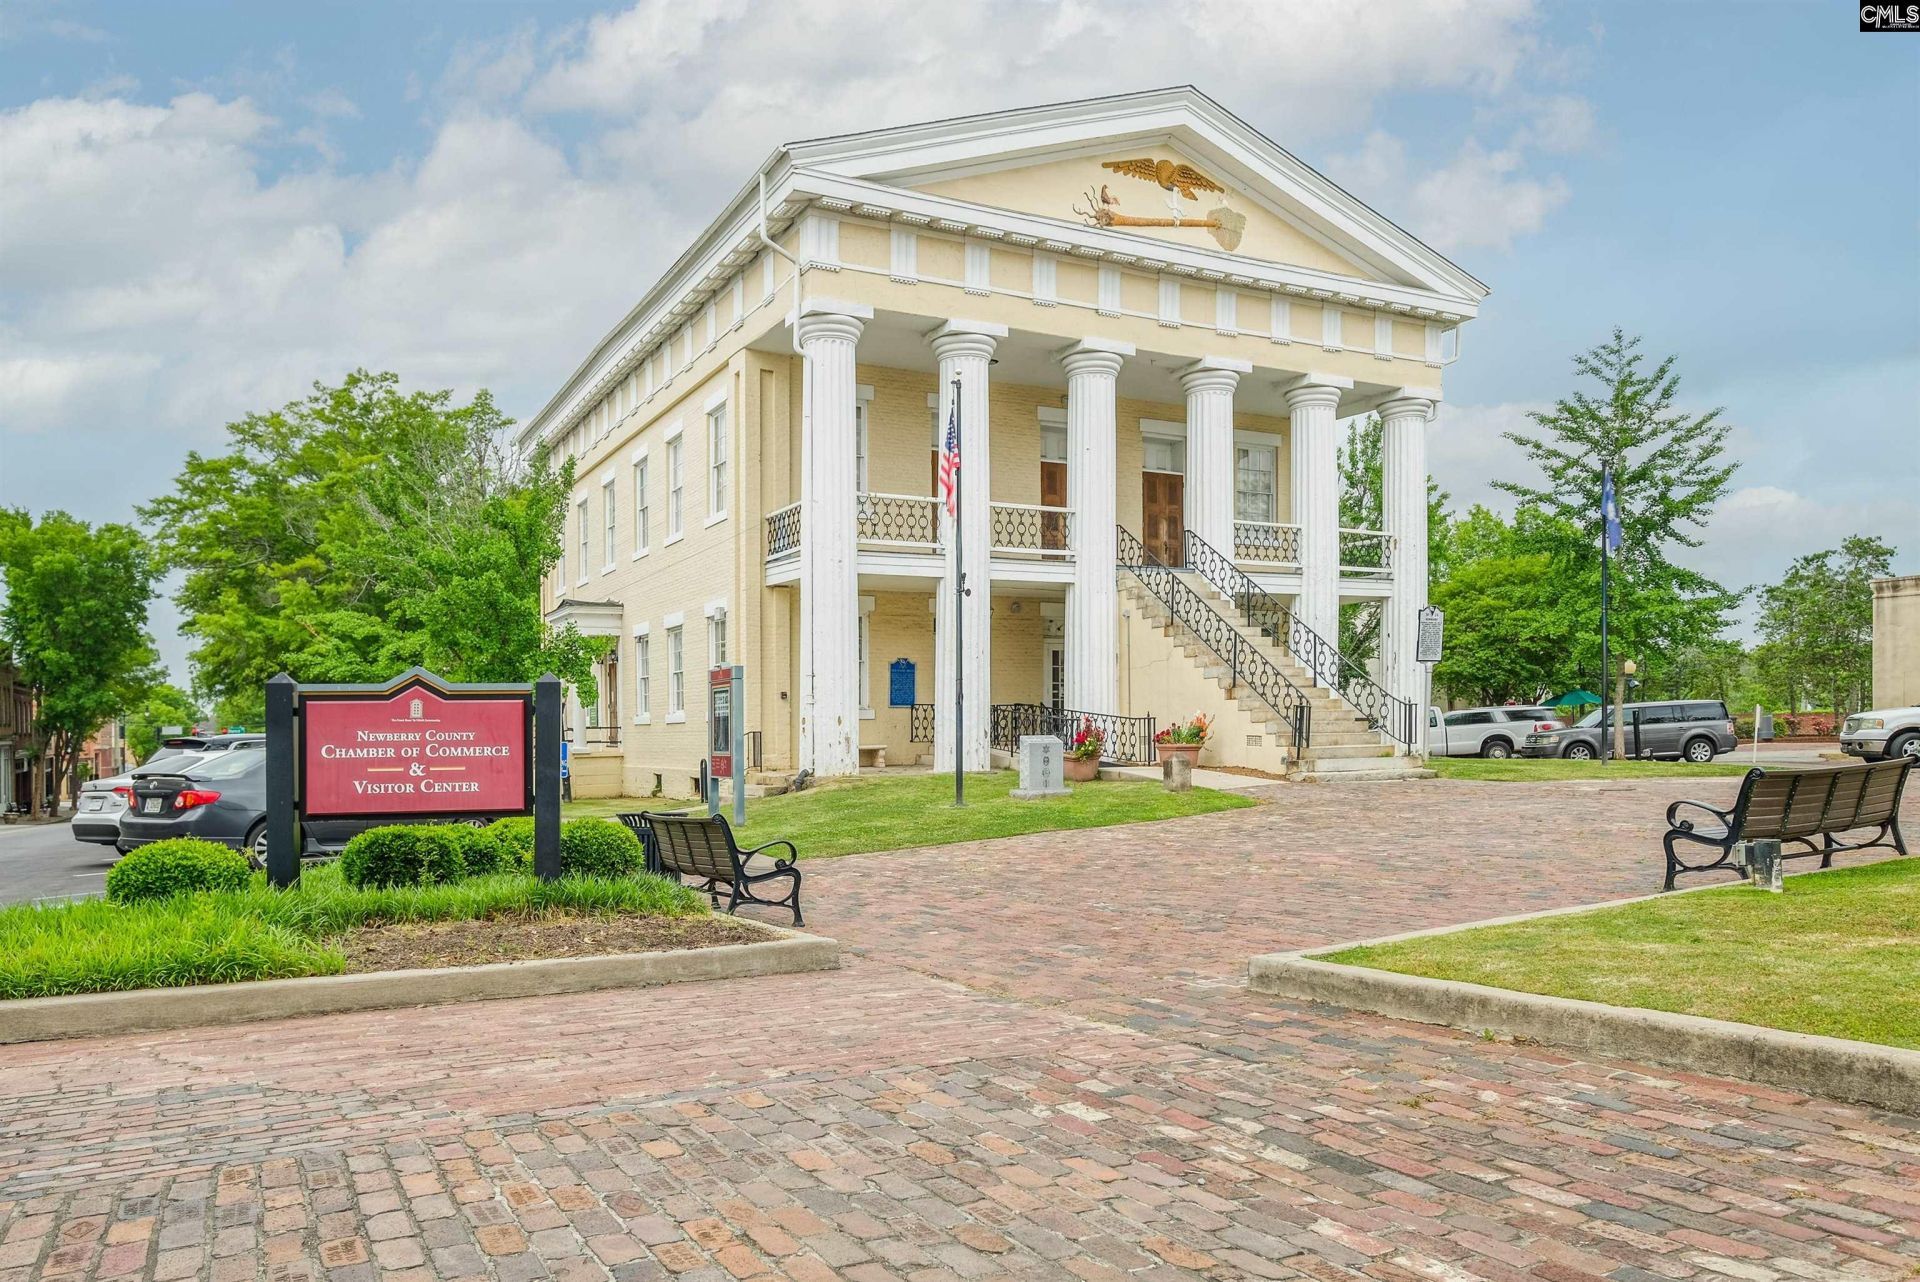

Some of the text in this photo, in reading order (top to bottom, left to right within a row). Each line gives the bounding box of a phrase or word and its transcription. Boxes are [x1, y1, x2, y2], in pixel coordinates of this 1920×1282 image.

[356, 729, 475, 742] NEWBERRY COUNTY
[320, 744, 396, 759] CHAMBER
[425, 743, 510, 757] COMMERCE
[409, 762, 426, 777] &
[352, 779, 480, 795] VISITOR CENTER
